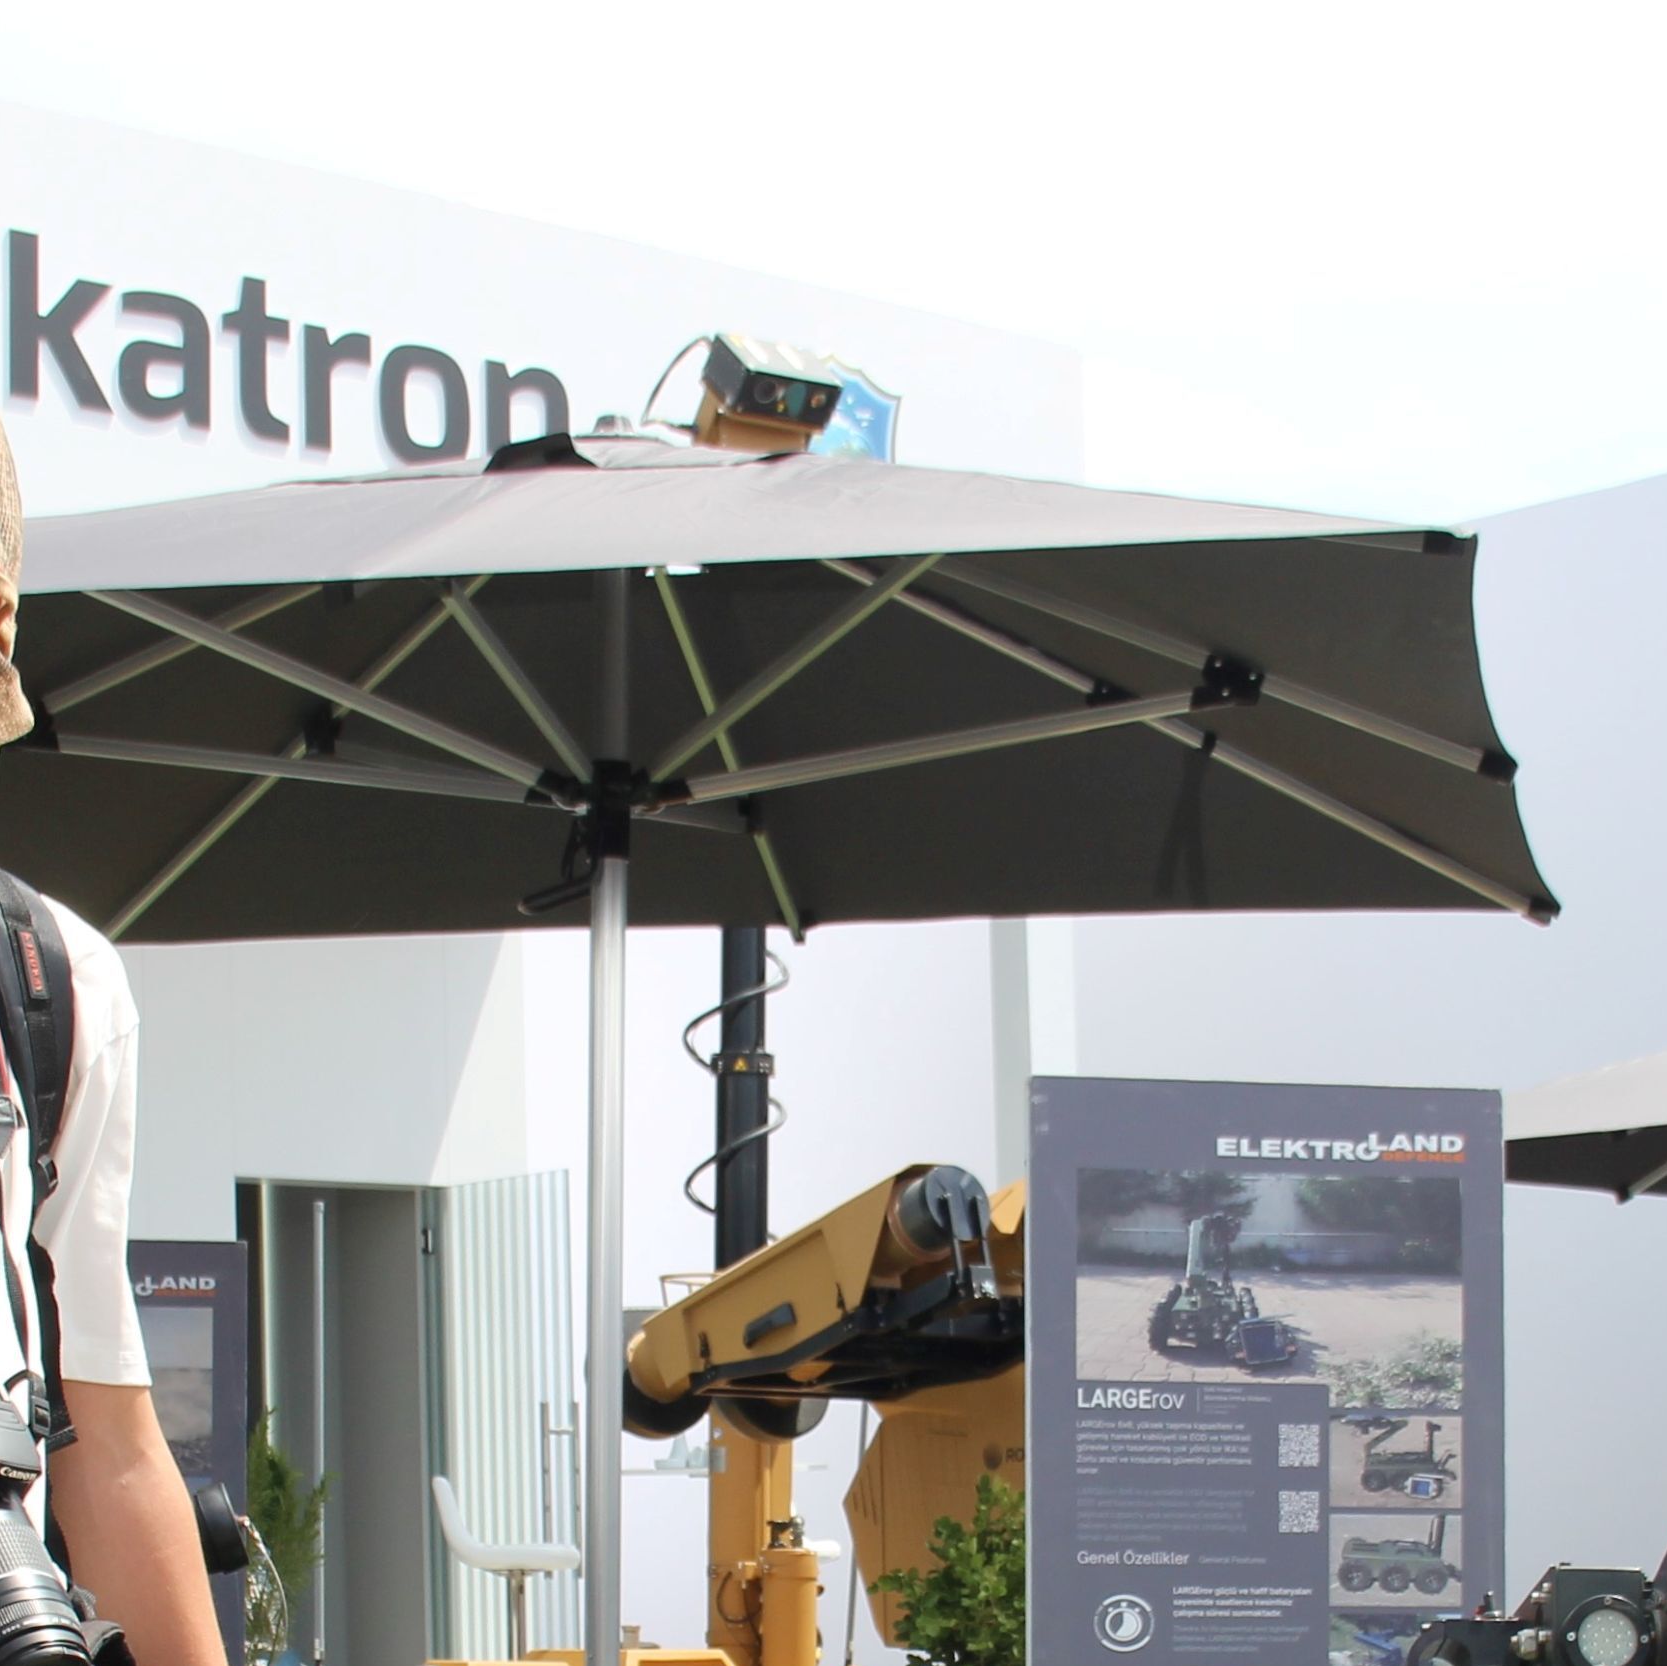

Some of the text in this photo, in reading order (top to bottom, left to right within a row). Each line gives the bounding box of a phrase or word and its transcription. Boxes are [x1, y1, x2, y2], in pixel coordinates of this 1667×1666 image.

[1217, 1133, 1463, 1162] ELEKTROLAND
[1077, 1388, 1185, 1409] LARGErov
[0, 1466, 37, 1482] Canon
[1077, 1551, 1120, 1565] Genel
[1123, 1550, 1190, 1565] Özellikler
